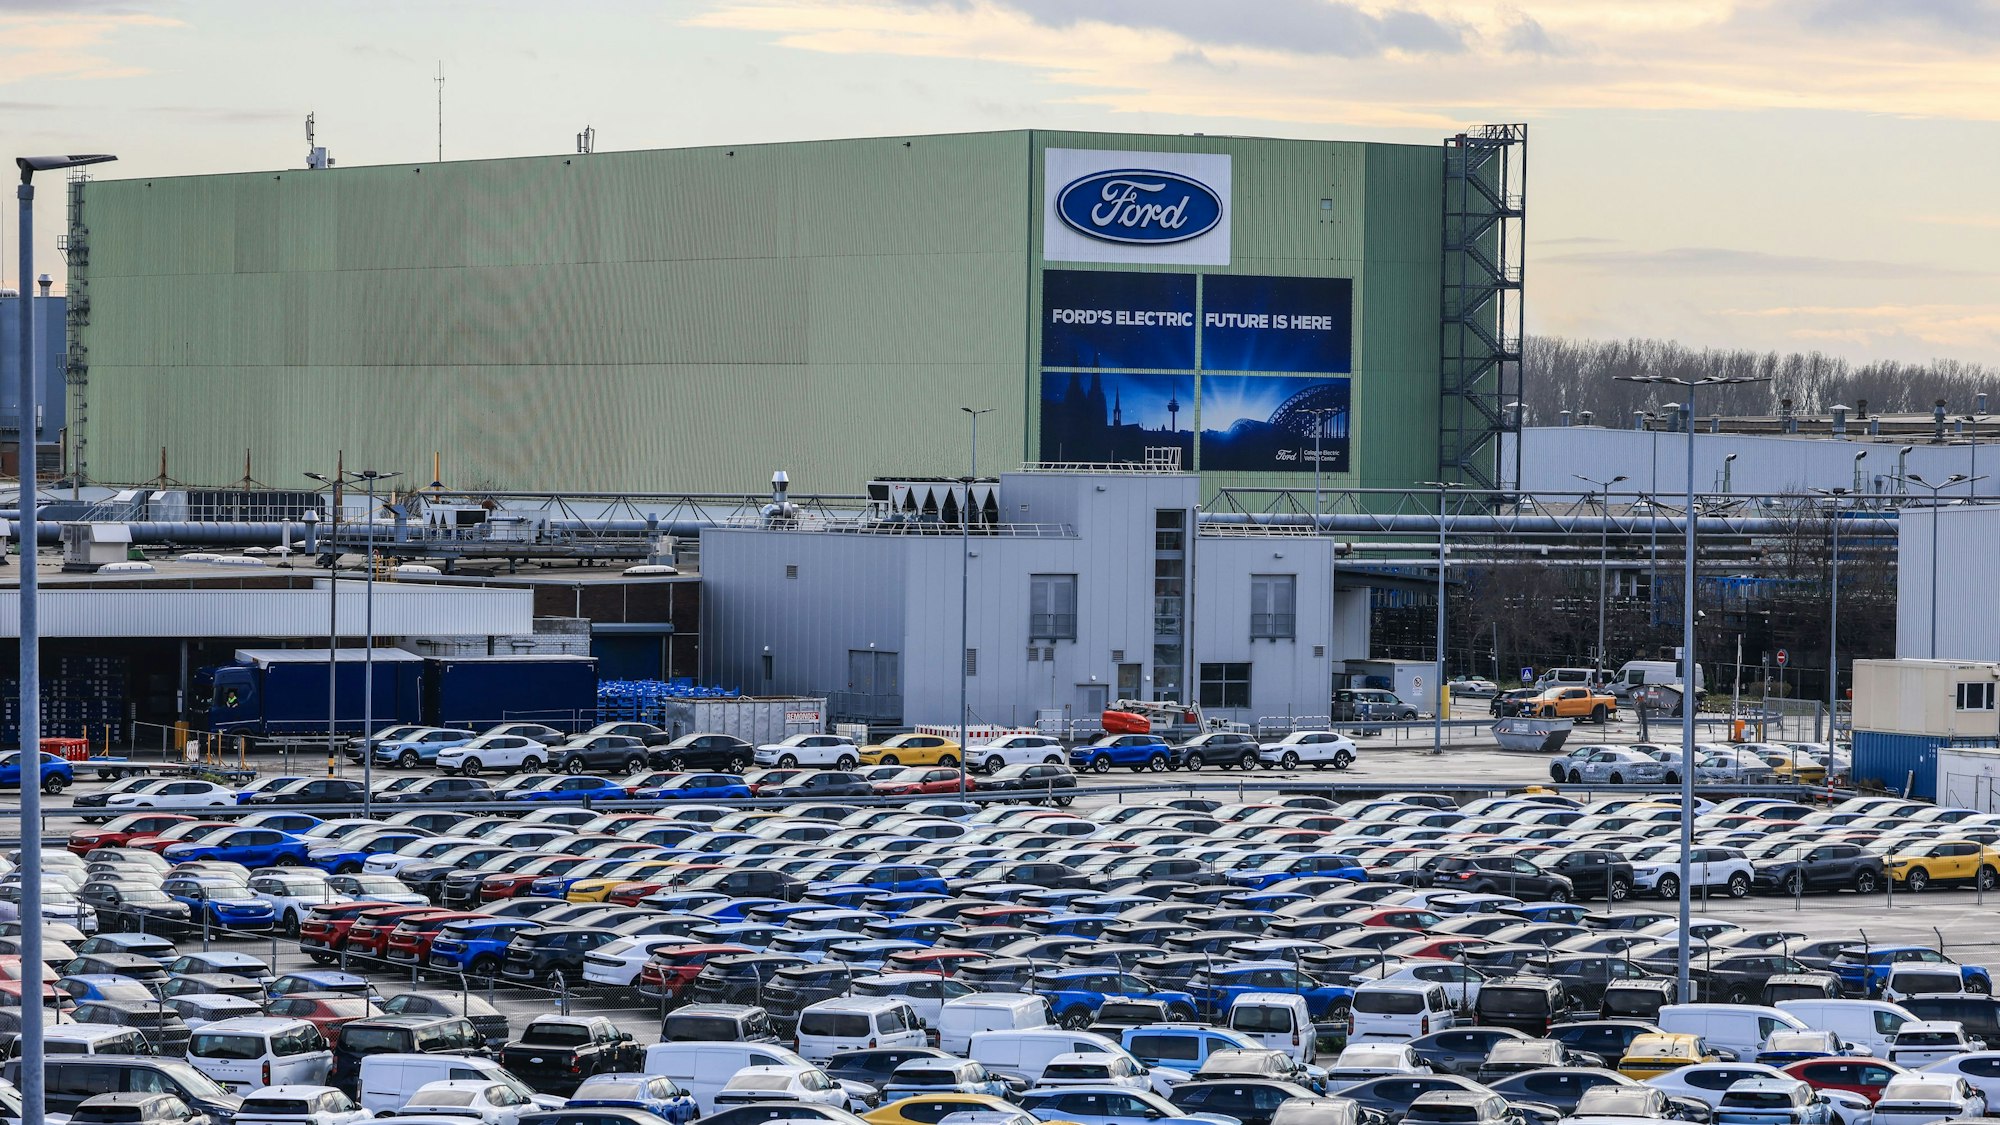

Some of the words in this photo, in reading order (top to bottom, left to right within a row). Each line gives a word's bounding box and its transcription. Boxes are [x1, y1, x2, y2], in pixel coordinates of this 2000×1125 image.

[1091, 179, 1191, 229] Ford
[1052, 308, 1113, 325] FORD'S
[1115, 310, 1193, 327] ELECTRIC
[1205, 312, 1269, 329] FUTURE
[1272, 314, 1288, 330] IS
[1290, 315, 1332, 331] HERE
[1275, 449, 1297, 461] Ford
